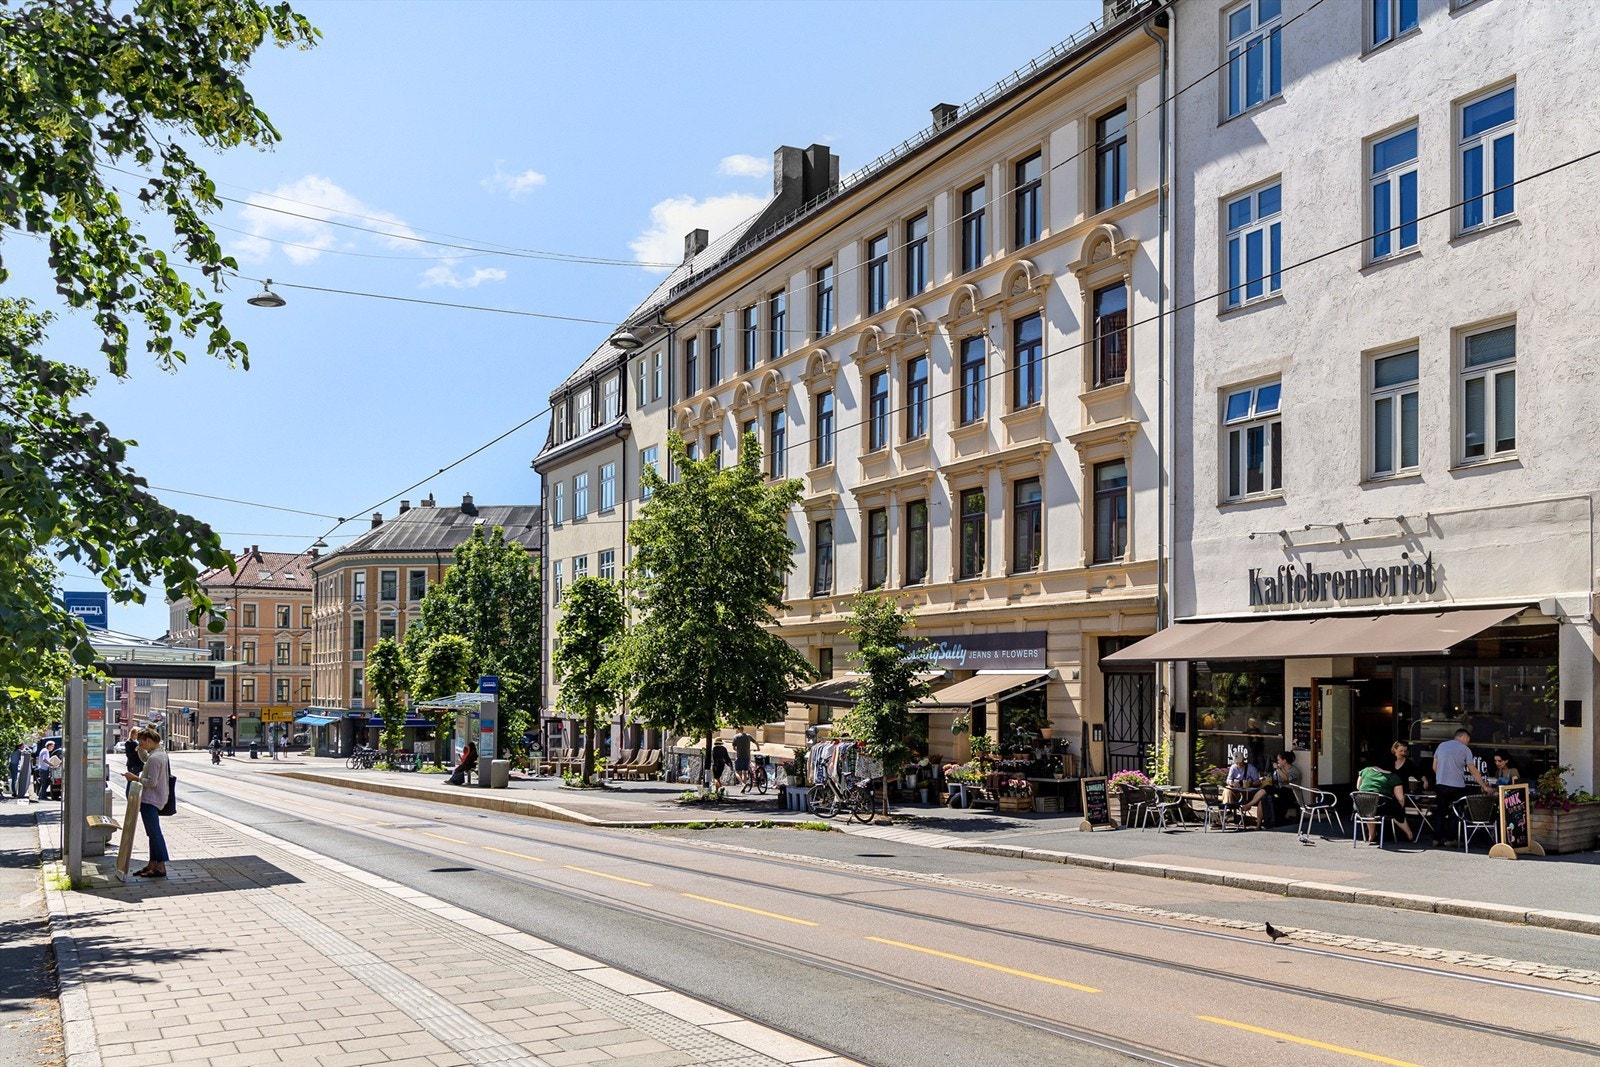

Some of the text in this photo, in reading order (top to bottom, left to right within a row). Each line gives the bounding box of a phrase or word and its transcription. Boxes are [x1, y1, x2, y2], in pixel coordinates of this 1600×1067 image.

[1248, 551, 1437, 606] Kaffebrenneriet
[968, 650, 992, 659] JEANS
[994, 649, 999, 658] &
[1001, 649, 1039, 658] FLOWERS
[1504, 792, 1521, 809] PINK
